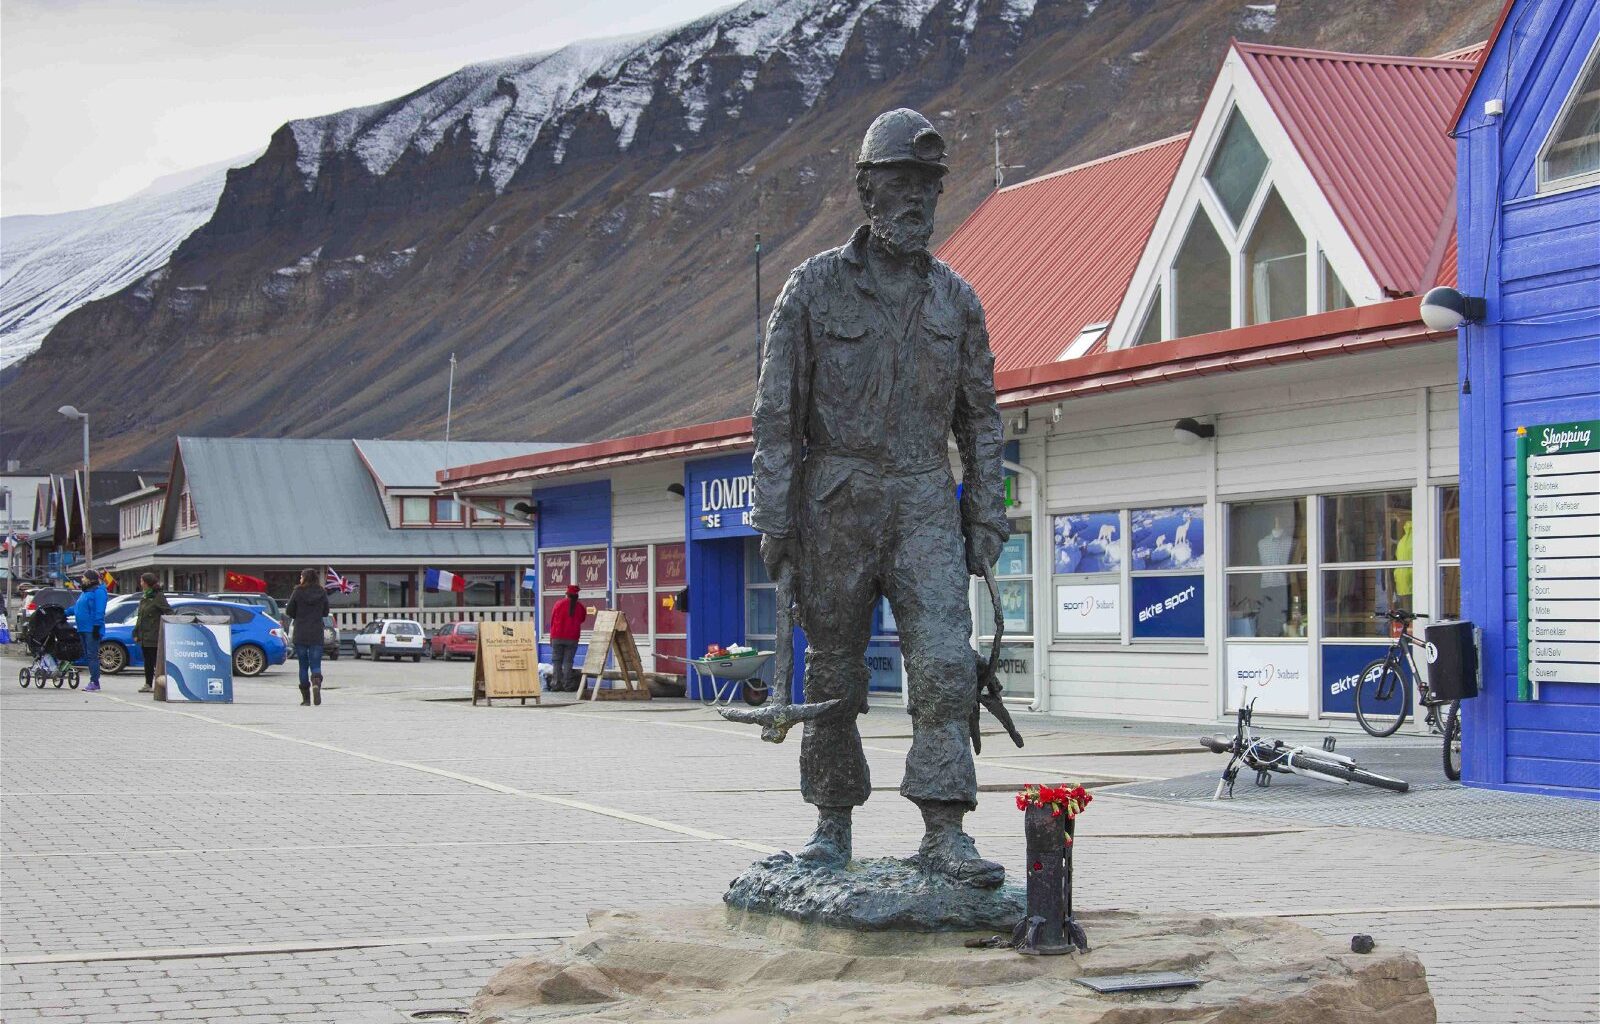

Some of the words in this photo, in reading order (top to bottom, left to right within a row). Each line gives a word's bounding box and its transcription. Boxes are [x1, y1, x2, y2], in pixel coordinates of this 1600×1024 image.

[1541, 426, 1590, 448] Shopping
[1534, 462, 1553, 470] Apotek
[1534, 482, 1558, 491] Bibliotek
[701, 475, 756, 511] LOMPE
[1556, 501, 1580, 510] Kaffebar
[1534, 544, 1546, 552] Pub
[551, 568, 563, 583] Pub
[586, 566, 598, 582] Pub
[626, 562, 639, 579] Pub
[1535, 586, 1550, 595] Sport
[1064, 602, 1084, 611] sport
[1138, 601, 1163, 622] ekte
[1164, 586, 1195, 610] sport
[174, 649, 208, 658] Souvenirs
[189, 662, 216, 671] Shopping
[868, 656, 893, 671] POTEK
[998, 659, 1026, 674] POTEK
[1238, 669, 1262, 680] sport
[1276, 669, 1299, 679] Svalbard
[1536, 668, 1558, 676] Suvenir
[1331, 674, 1360, 695] ekte
